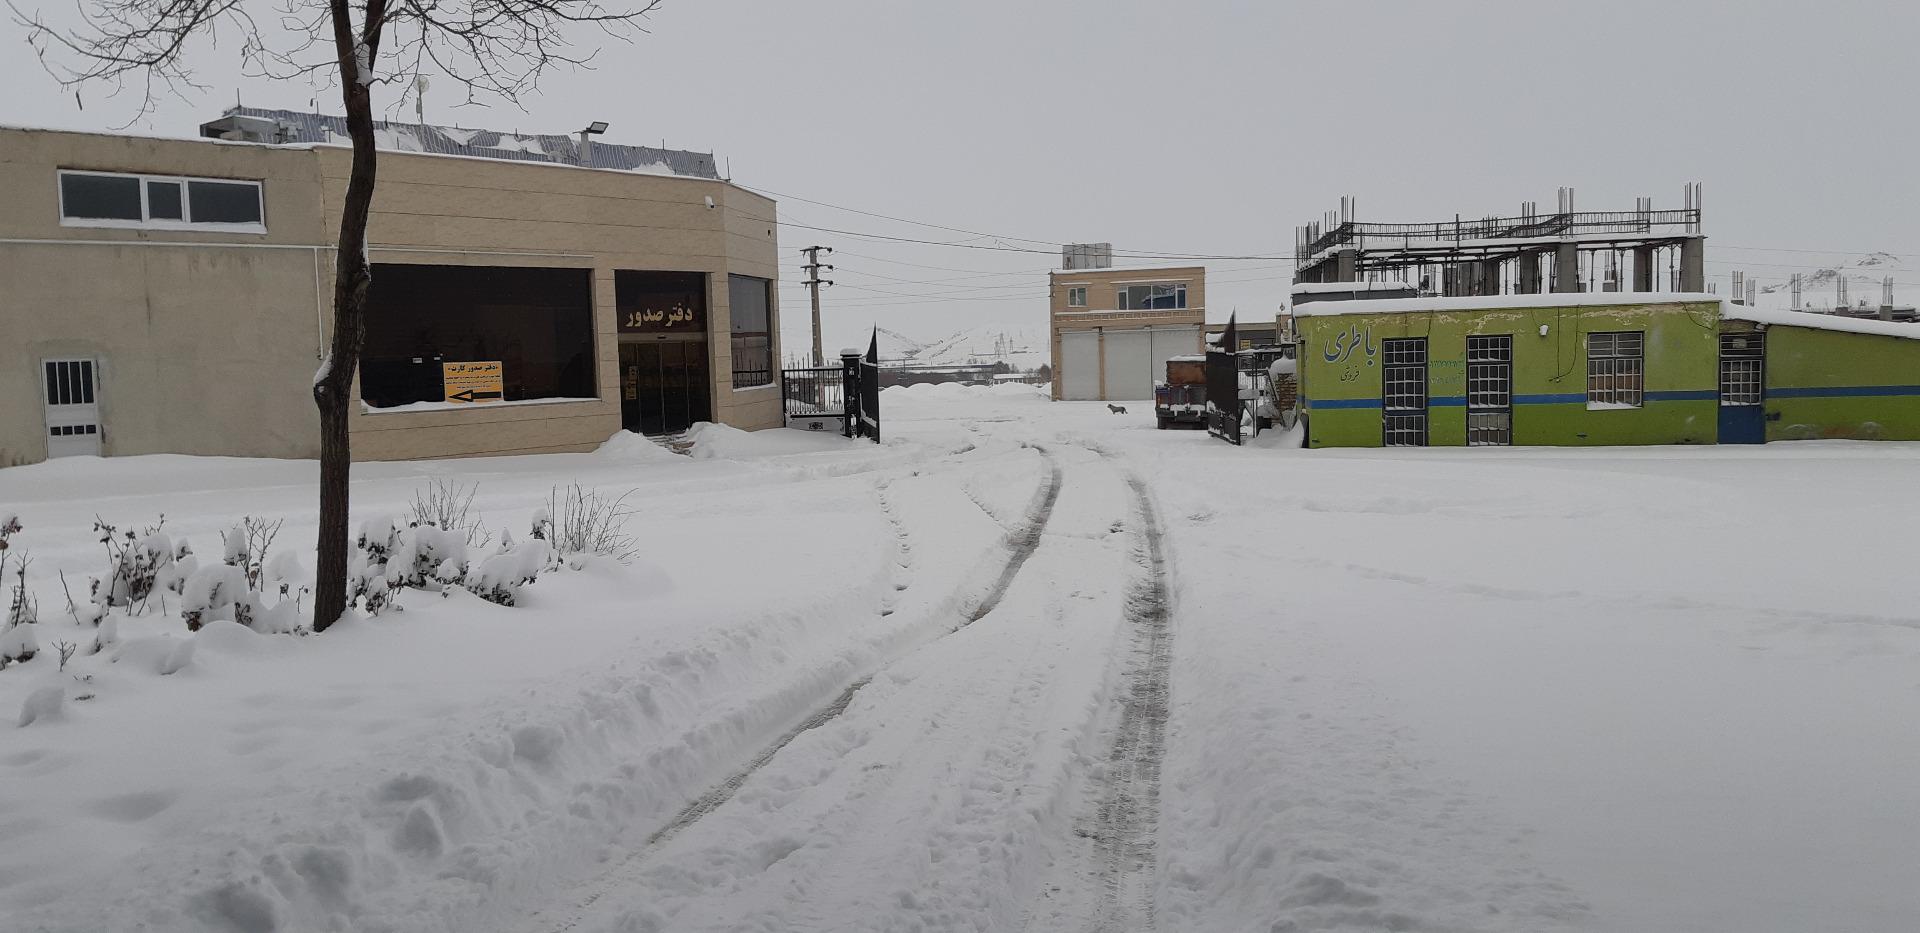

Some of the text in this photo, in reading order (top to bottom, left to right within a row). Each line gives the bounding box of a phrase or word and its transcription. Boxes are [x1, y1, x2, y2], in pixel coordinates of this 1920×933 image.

[625, 302, 693, 327] دفتر صدور
[1323, 323, 1377, 367] باطری
